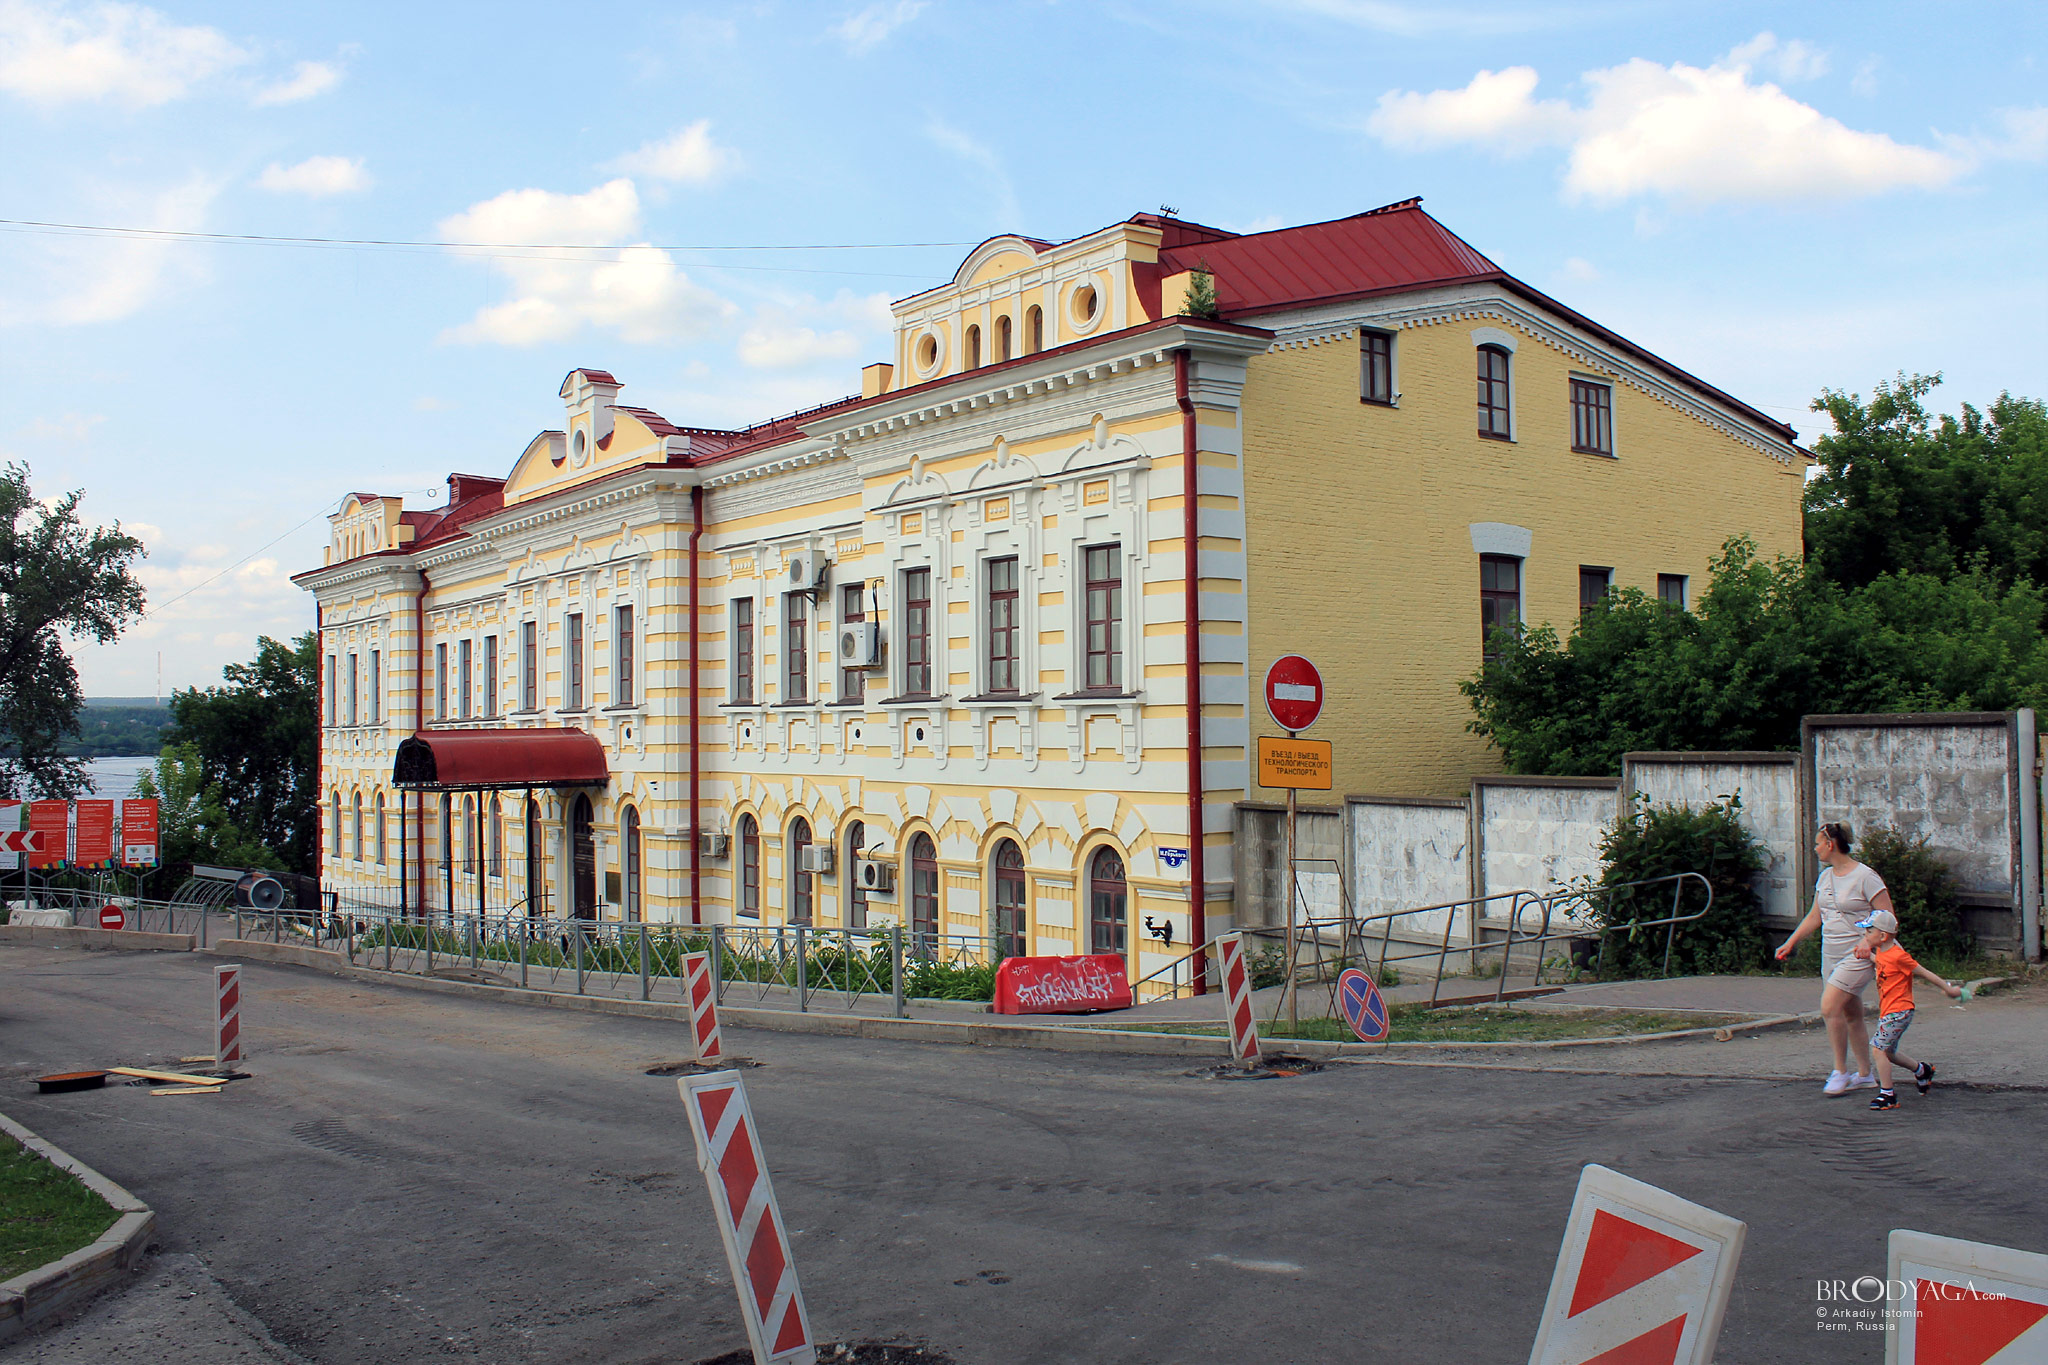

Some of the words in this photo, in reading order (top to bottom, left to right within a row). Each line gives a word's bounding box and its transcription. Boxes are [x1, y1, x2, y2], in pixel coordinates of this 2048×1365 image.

[1271, 750, 1292, 759] ВЪЕЗД
[1297, 751, 1319, 760] ВЫЕЗД
[1265, 758, 1328, 768] ТЕХНОЛОГИЧЕСКОГО
[1276, 767, 1317, 775] ТРАНСПОРТА
